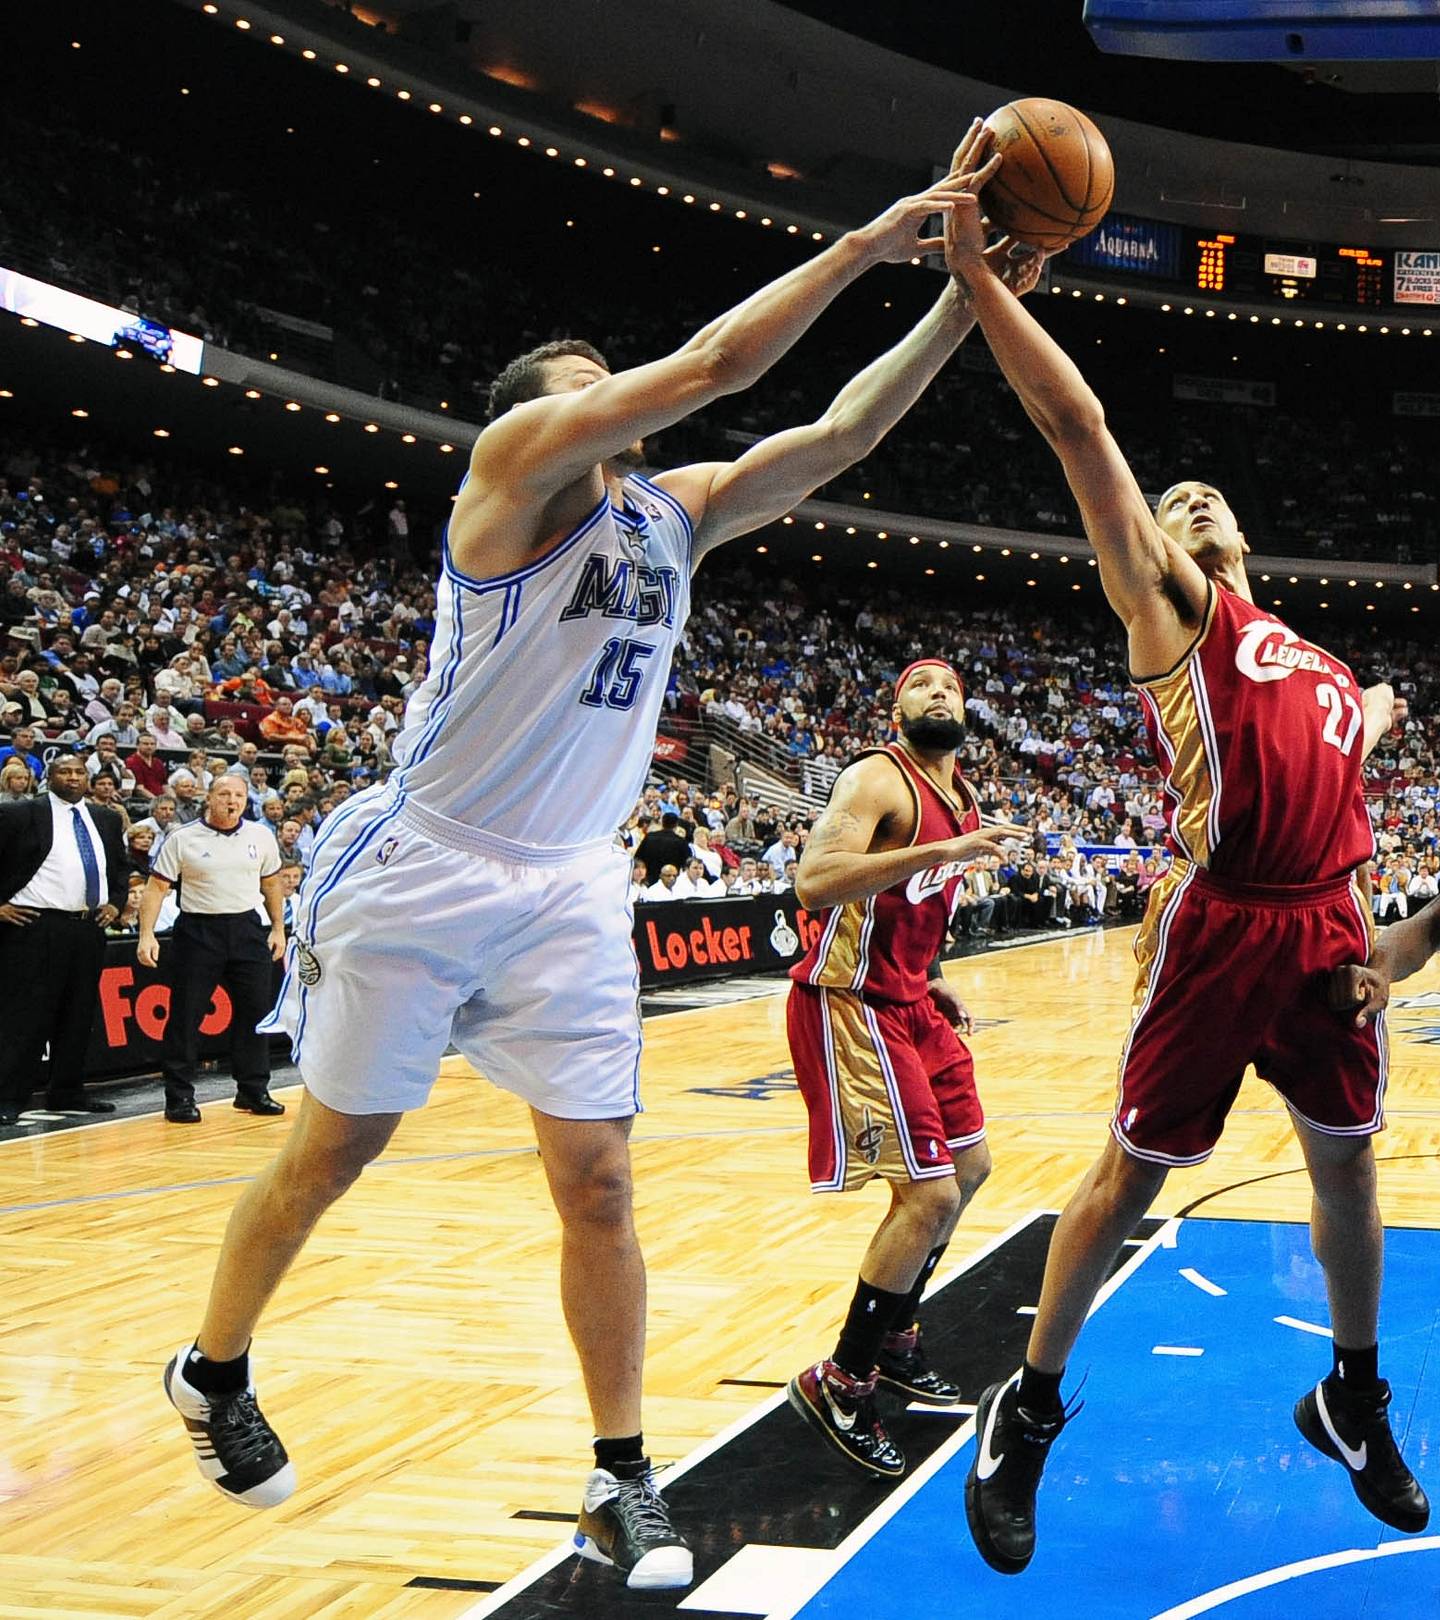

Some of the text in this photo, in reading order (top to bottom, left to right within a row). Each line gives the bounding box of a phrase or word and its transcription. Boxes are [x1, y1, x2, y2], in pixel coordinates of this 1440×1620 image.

[1396, 276, 1405, 291] 7
[559, 553, 681, 630] MGI
[579, 636, 657, 711] 15
[1315, 683, 1363, 757] 21
[646, 916, 752, 972] Locker
[796, 909, 821, 951] Fo
[99, 967, 233, 1048] Foo
